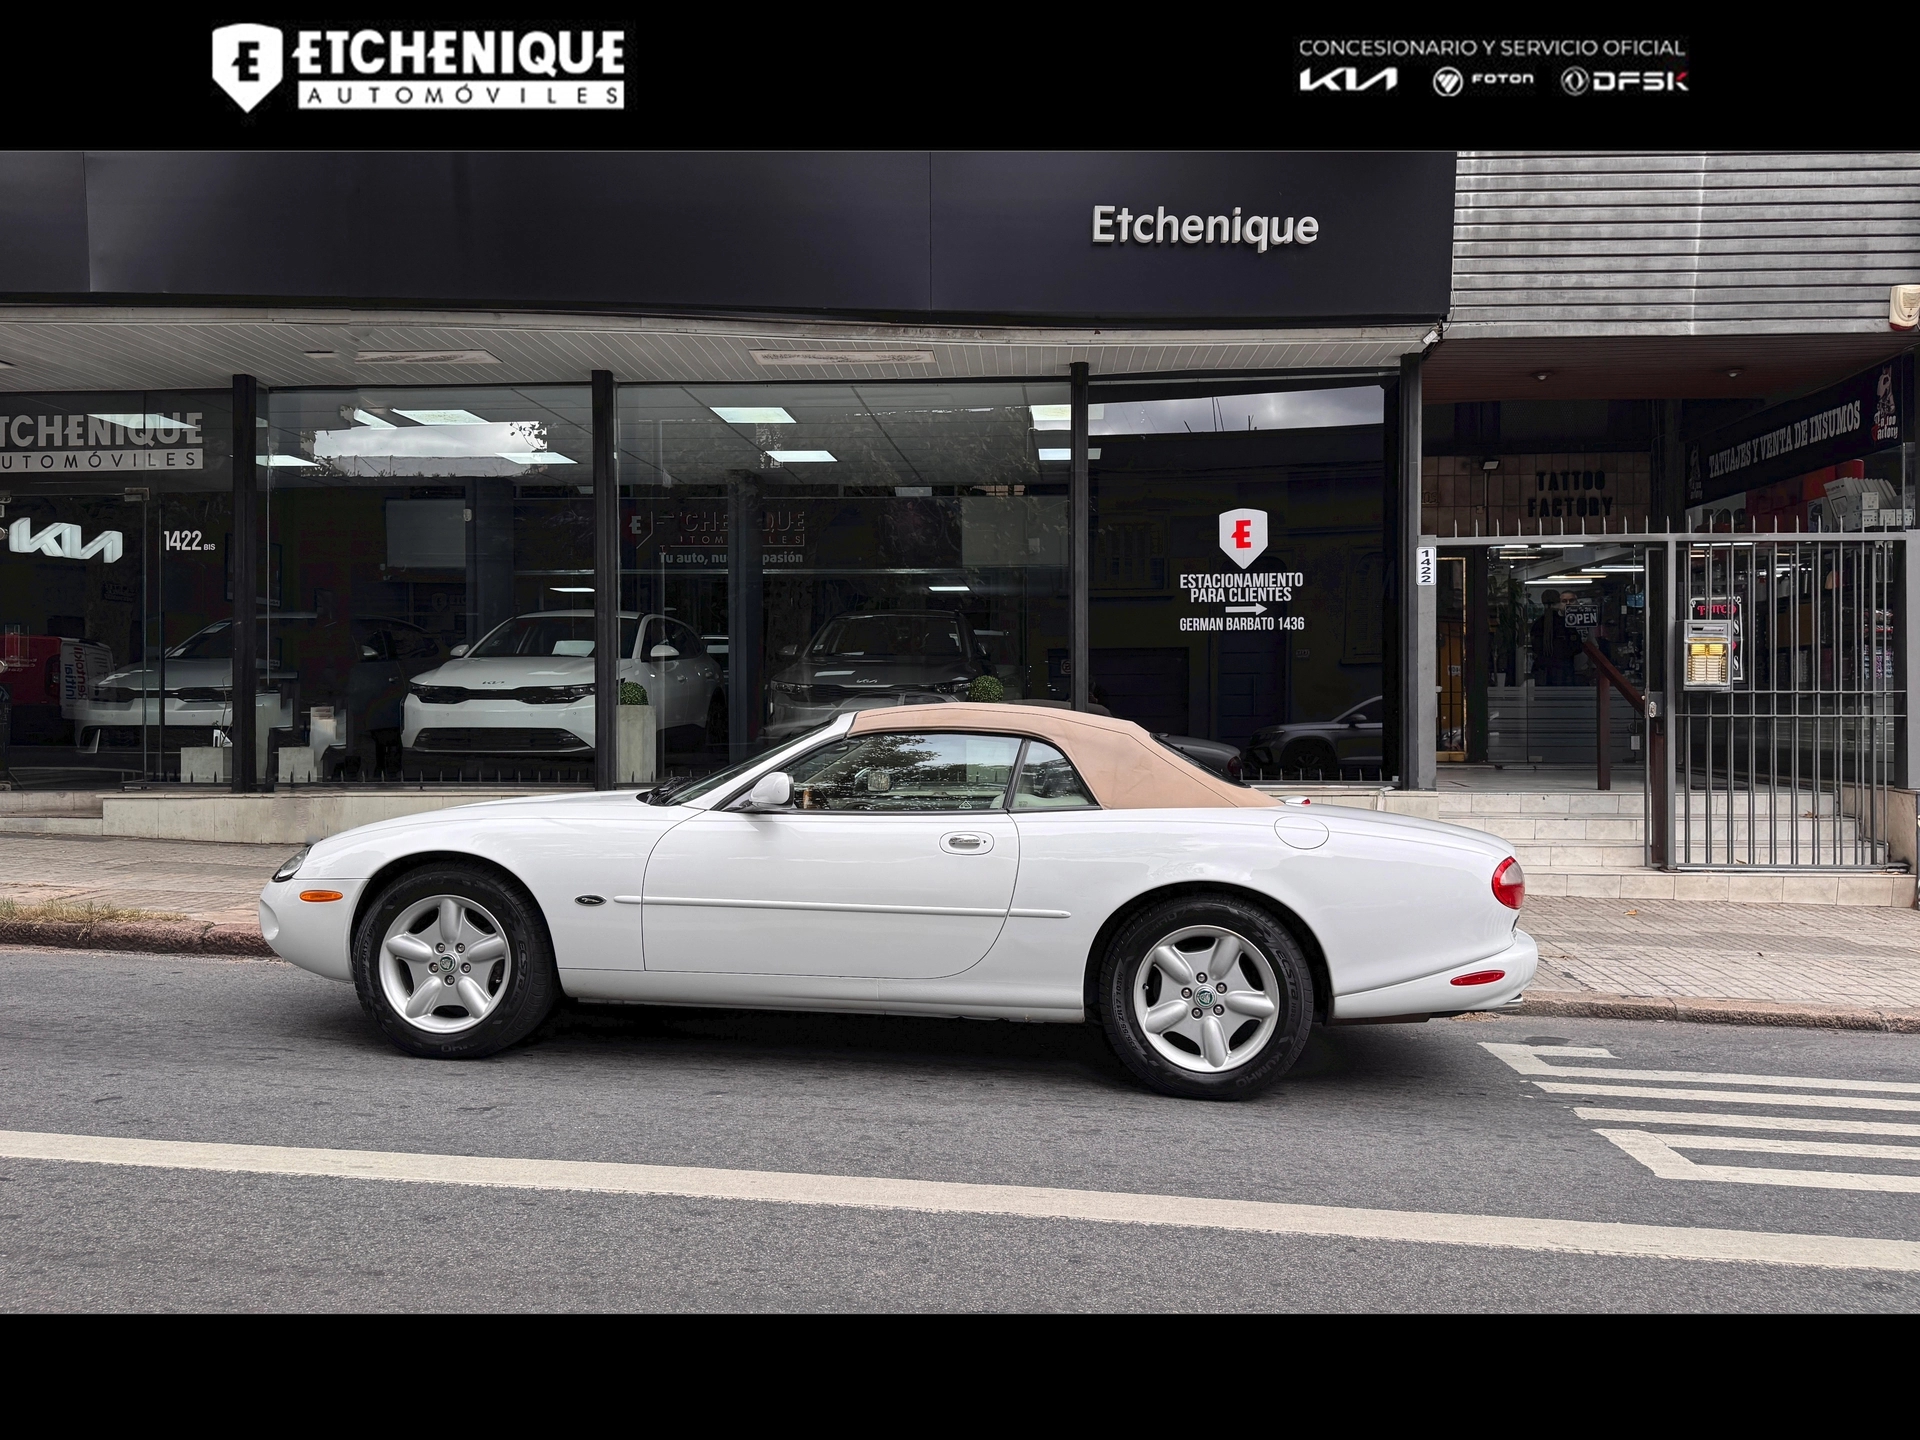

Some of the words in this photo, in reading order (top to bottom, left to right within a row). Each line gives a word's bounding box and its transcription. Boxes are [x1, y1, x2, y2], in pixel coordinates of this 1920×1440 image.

[1093, 205, 1319, 253] Etchenique
[1709, 440, 1752, 478] TATUAJES
[1752, 438, 1760, 464] Y
[1760, 426, 1794, 460] VENTA
[1794, 415, 1808, 449] DE
[1810, 400, 1861, 443] INSUMOS
[1536, 470, 1605, 491] TATTOO
[1528, 497, 1613, 517] FACTORY
[9, 518, 123, 563] KIA
[164, 531, 202, 550] 1422
[1231, 520, 1251, 548] E
[676, 552, 709, 565] auto,
[762, 551, 804, 565] pasión
[1421, 550, 1431, 582] 1422
[1180, 572, 1303, 588] ESTACIONAMIENTO
[1190, 588, 1225, 602] PARA
[1229, 587, 1292, 601] CLIENTES
[1180, 617, 1223, 631] GERMAN
[1226, 617, 1274, 630] BARBATO
[1278, 617, 1305, 630] 1436
[1565, 613, 1597, 625] OPEN
[1235, 1051, 1284, 1089] KUMHO
